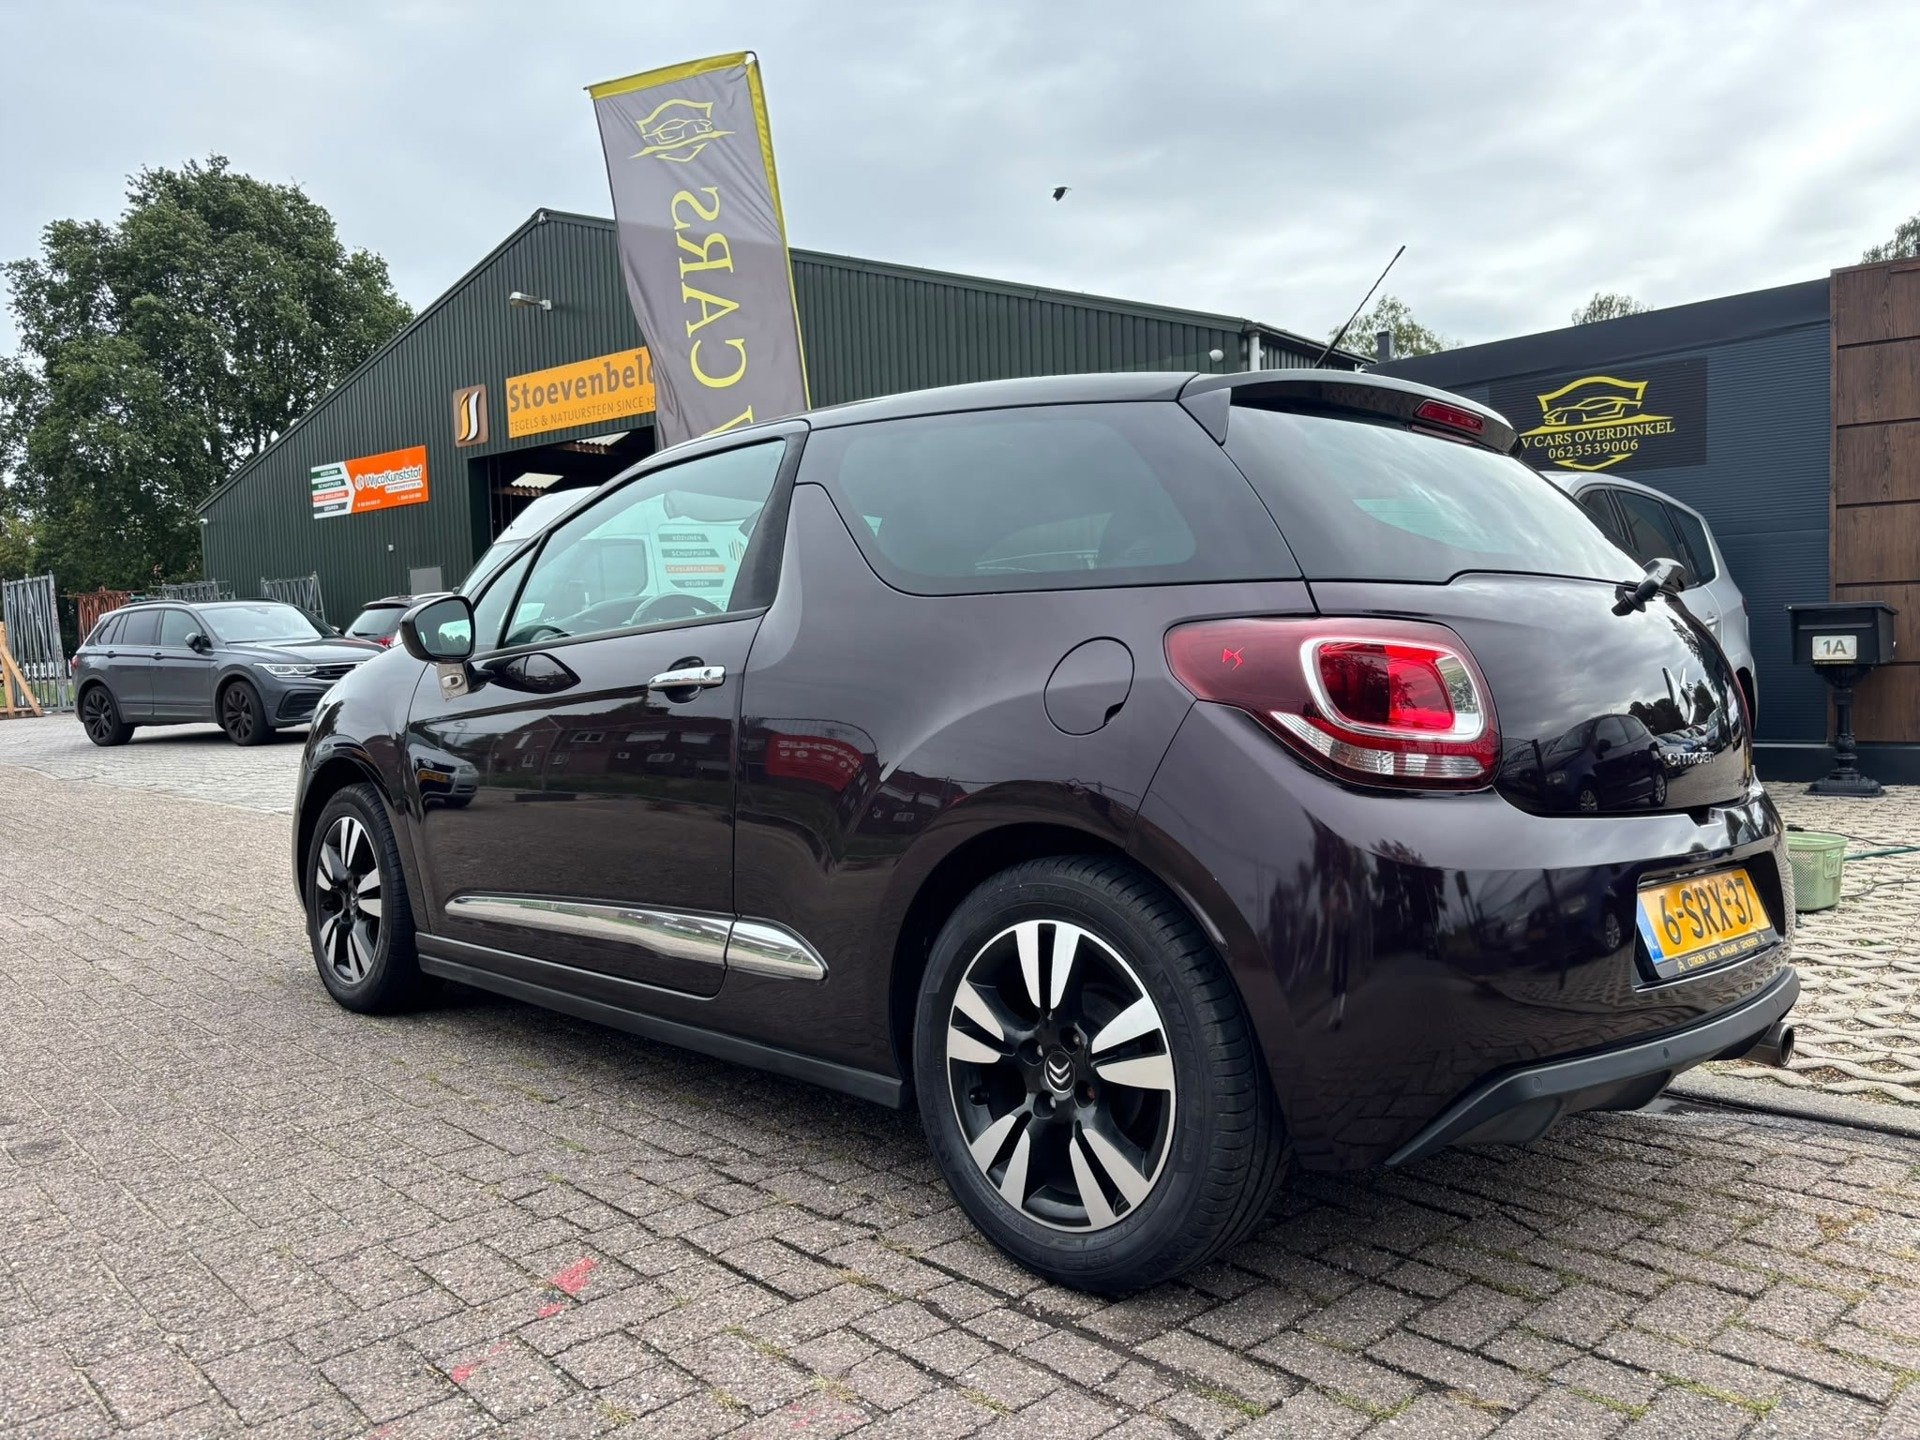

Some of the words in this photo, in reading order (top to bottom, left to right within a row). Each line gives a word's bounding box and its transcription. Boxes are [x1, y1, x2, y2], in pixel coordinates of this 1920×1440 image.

[511, 417, 539, 432] TEGELS
[541, 414, 549, 426] &
[551, 403, 614, 423] NATUURSTEEN
[617, 397, 644, 411] SINCE
[1534, 433, 1572, 447] CARS
[1575, 421, 1676, 443] OVERDINKEL
[1548, 439, 1639, 459] 0623539006
[1823, 639, 1847, 655] 1A
[1659, 877, 1754, 945] 6-SRX-37
